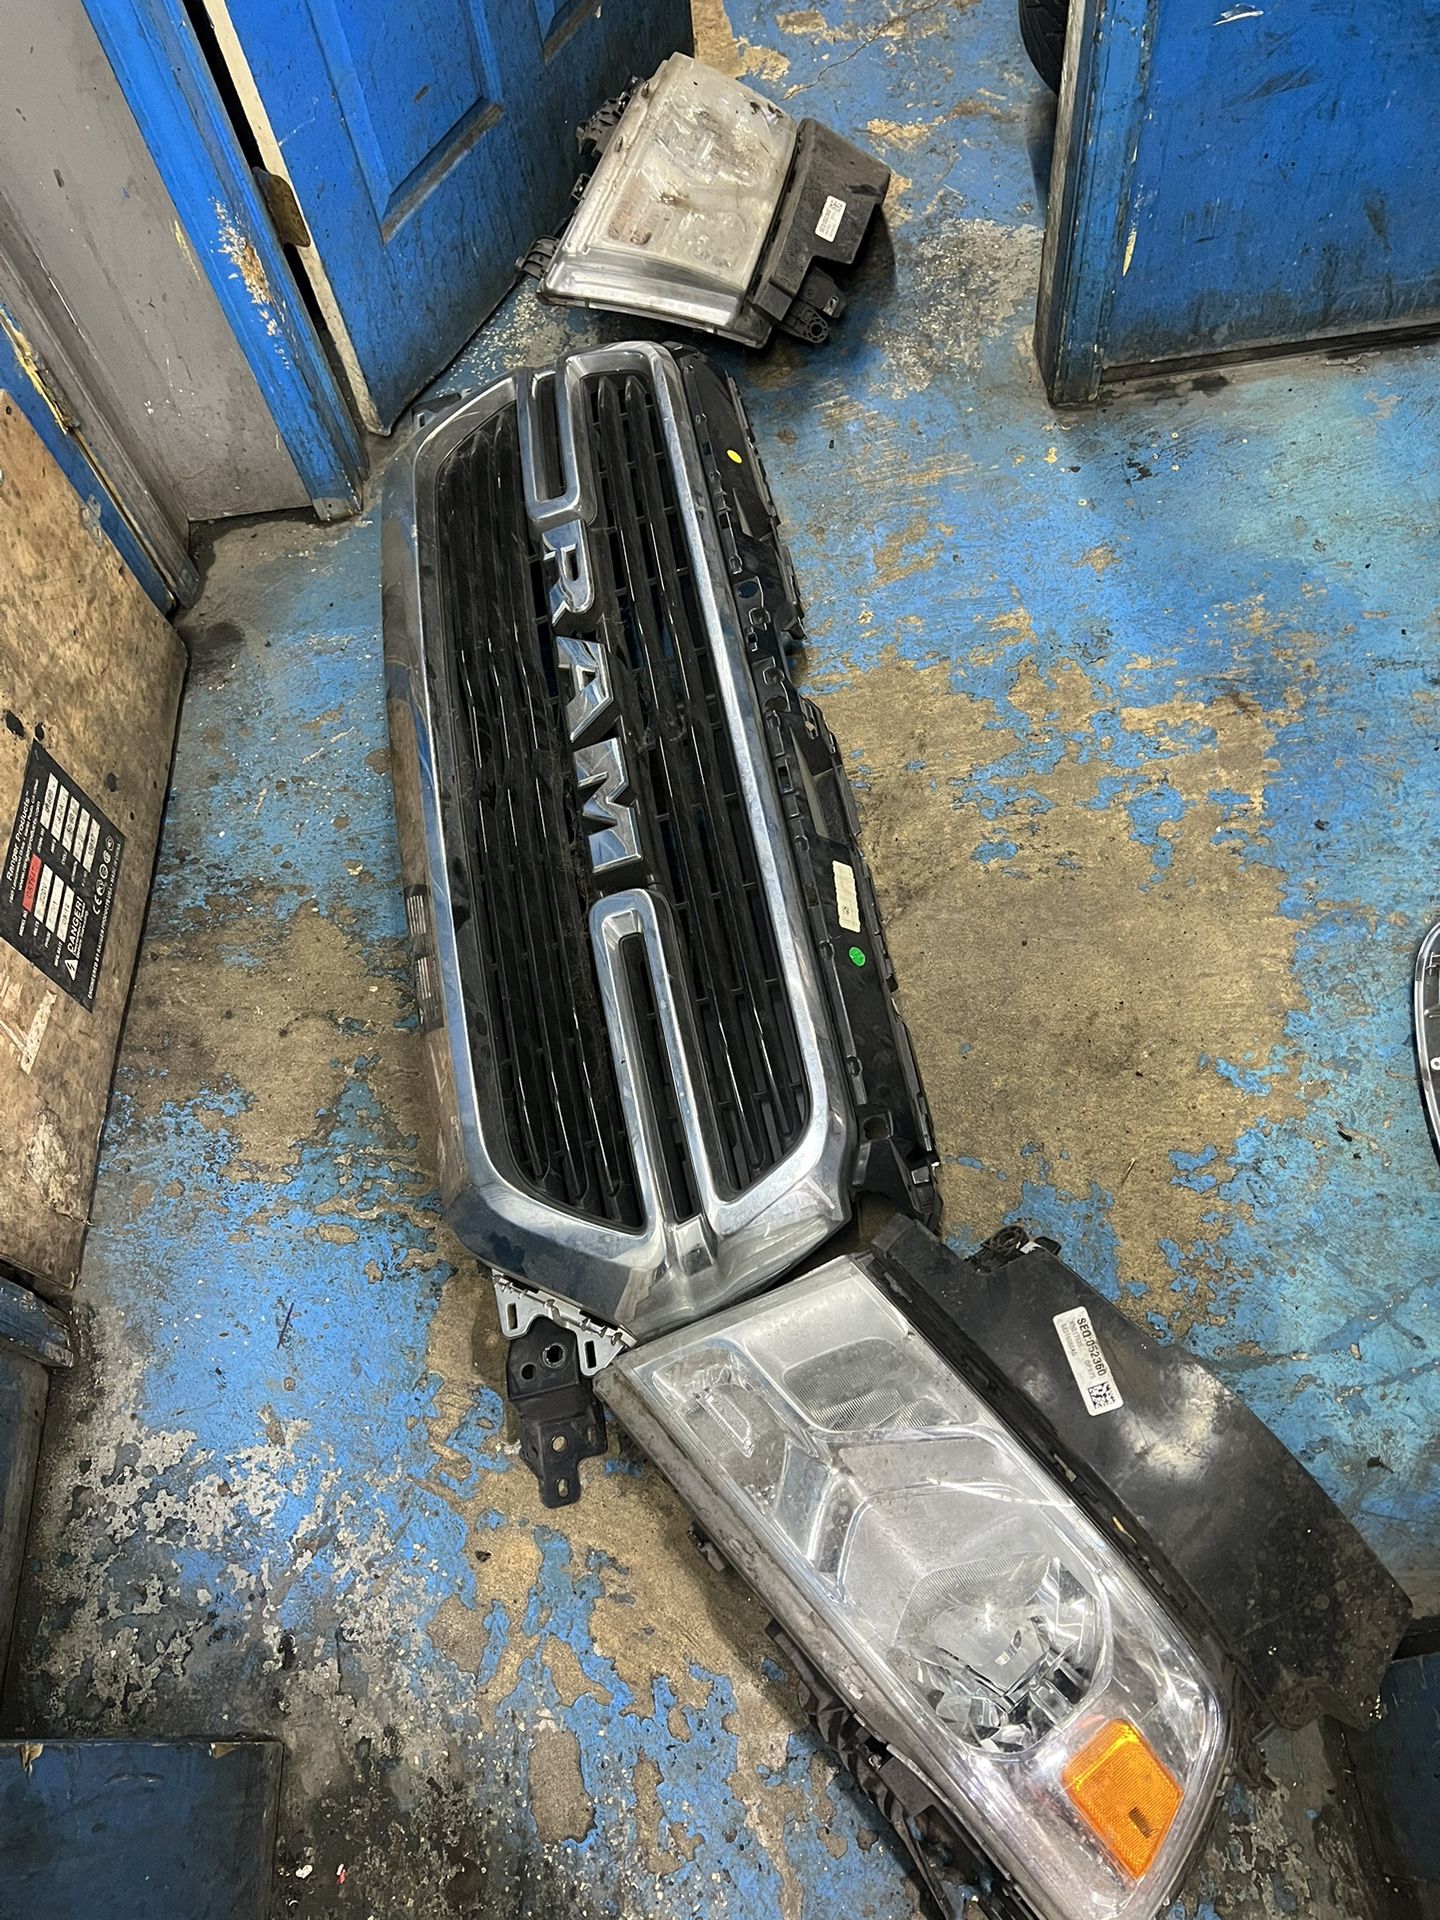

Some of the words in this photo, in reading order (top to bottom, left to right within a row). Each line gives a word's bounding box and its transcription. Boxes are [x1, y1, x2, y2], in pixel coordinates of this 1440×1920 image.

[542, 519, 643, 874] RAM
[5, 841, 21, 884] Ranger
[66, 894, 83, 954] DANGER!
[87, 959, 99, 1001] ENGINEERED
[96, 927, 105, 955] RANGER
[1077, 1317, 1107, 1376] SEQ:052360
